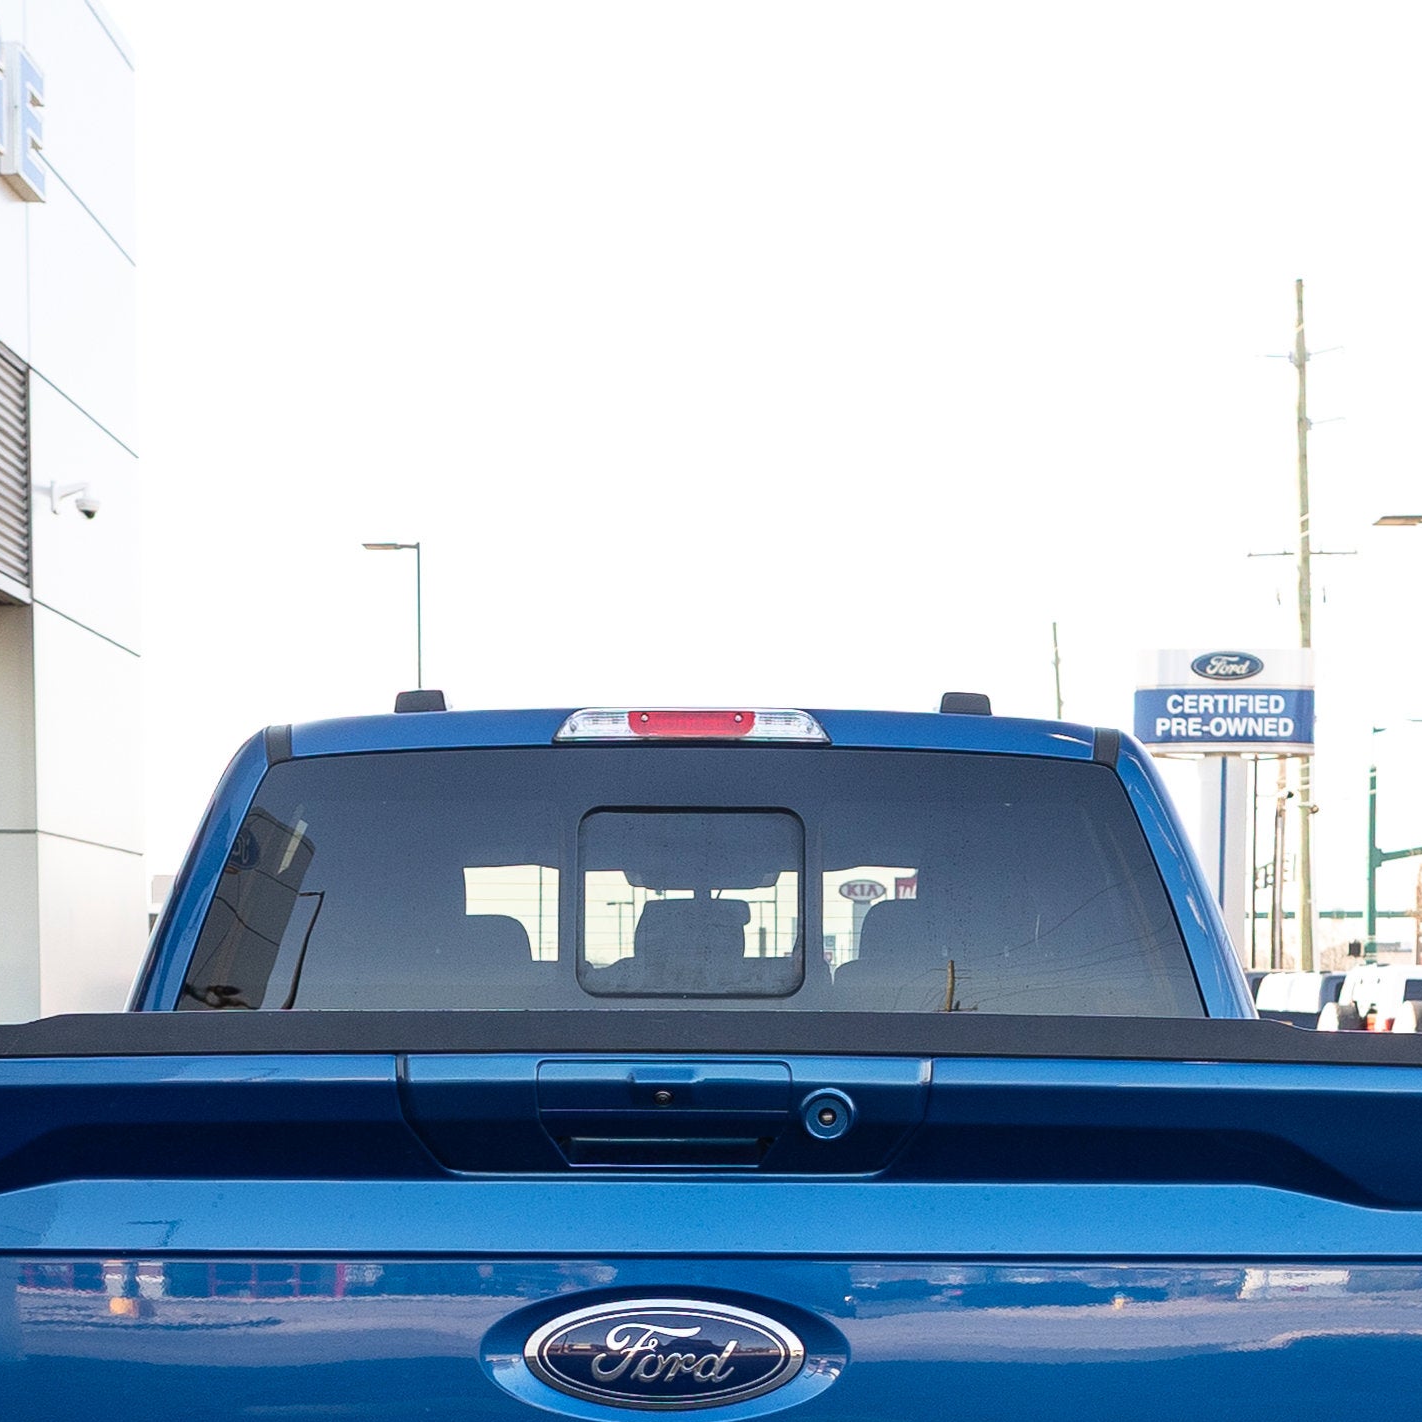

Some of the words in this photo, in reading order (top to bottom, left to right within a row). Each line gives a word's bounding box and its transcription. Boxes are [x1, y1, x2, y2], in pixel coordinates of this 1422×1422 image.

[1205, 655, 1250, 676] Ford
[1165, 694, 1286, 714] CERTIFIED
[1155, 717, 1295, 737] PRE-OWNED
[845, 884, 879, 897] KIA
[591, 1322, 739, 1383] Ford
